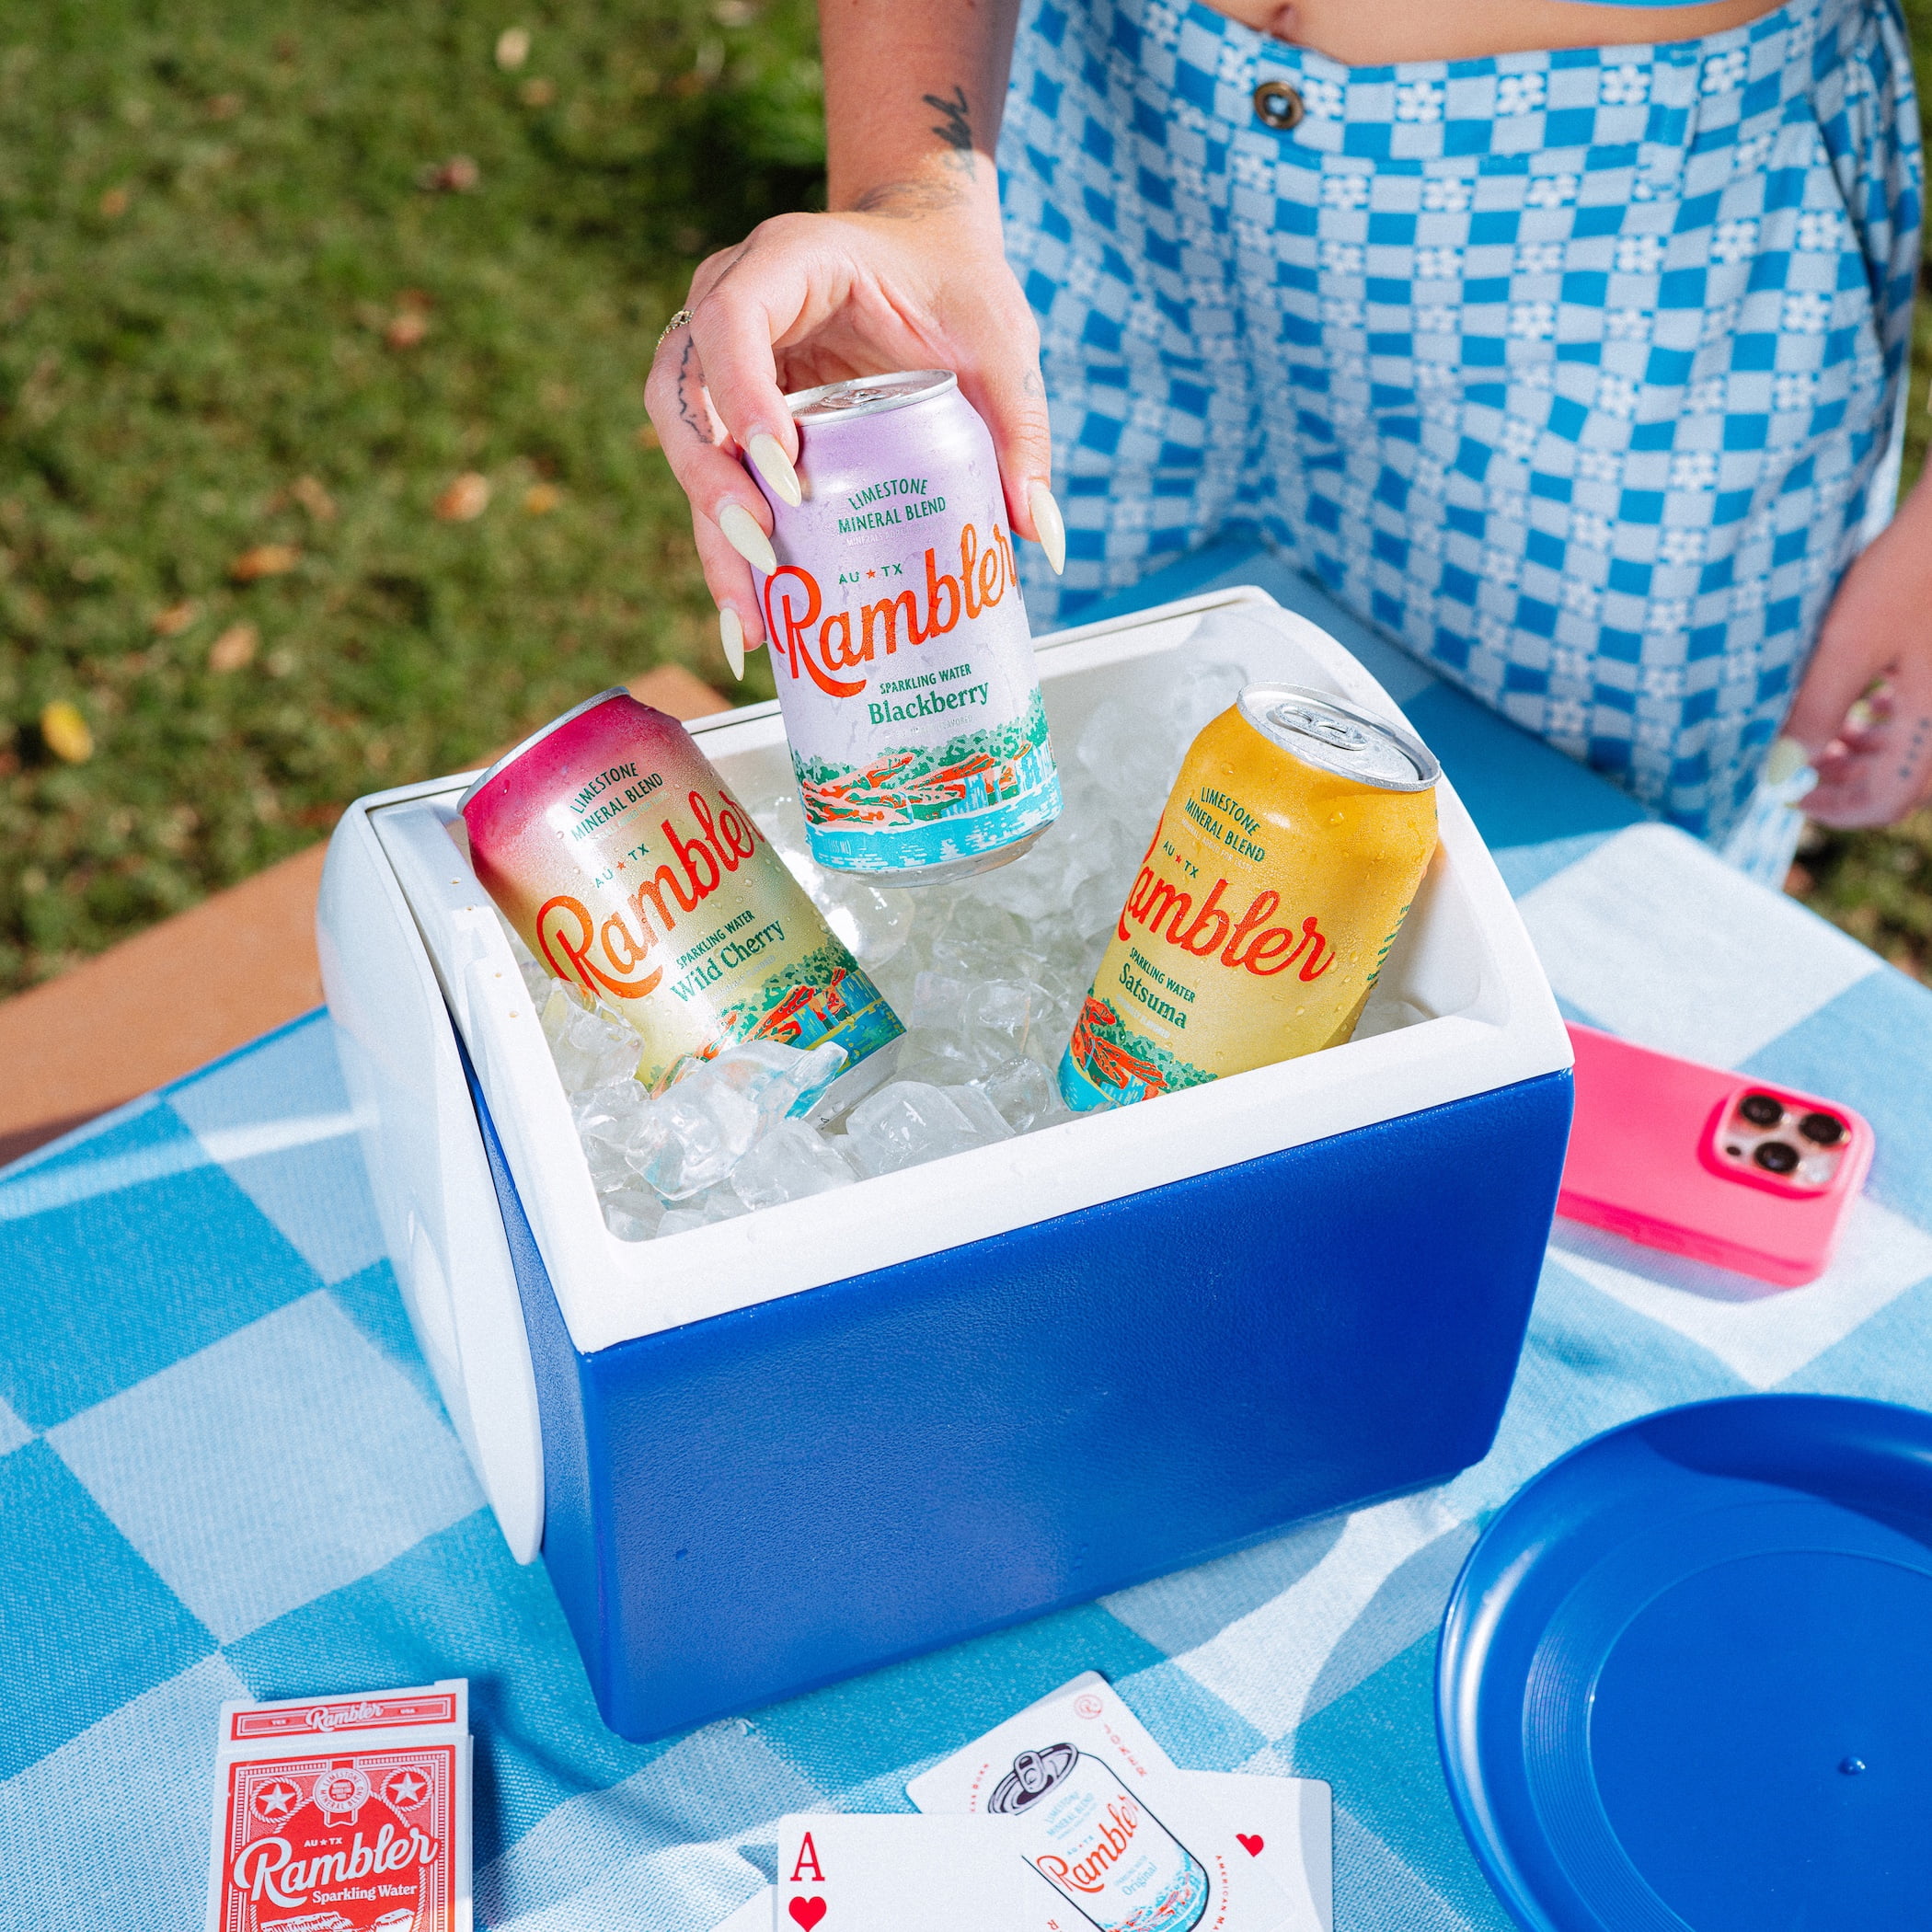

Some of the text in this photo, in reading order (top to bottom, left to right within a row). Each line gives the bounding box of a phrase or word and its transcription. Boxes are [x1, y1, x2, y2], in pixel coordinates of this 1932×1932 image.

[838, 508, 902, 534] MINERAL
[904, 497, 946, 521] BLEND
[848, 478, 928, 511] LIMESTONE
[839, 563, 903, 585] AU TX
[765, 523, 1016, 698] Rambler
[868, 682, 989, 725] Blackberry
[880, 663, 972, 695] SPARKLING WATER
[569, 763, 638, 814] LIMESTONE
[570, 797, 627, 842] MINERAL
[625, 773, 663, 803] BLEND
[1201, 787, 1260, 836] LIMESTONE
[1184, 798, 1221, 840] MINERAL
[1225, 830, 1265, 863] BLEND
[595, 844, 650, 889] AU TX
[1163, 840, 1199, 879] AU TX
[536, 790, 765, 999] Rambler
[670, 958, 723, 1002] Wild
[721, 920, 785, 969] Cherry
[676, 910, 755, 970] SPARKLING WATER
[1119, 962, 1187, 1029] Satsuma
[1129, 947, 1196, 1004] SPARKLING WATER
[305, 1701, 384, 1732] Rambler
[1104, 1723, 1147, 1777] JOKER
[233, 1823, 438, 1908] Rambler
[305, 1836, 343, 1848] AU TX
[789, 1831, 826, 1881] A
[1037, 1794, 1139, 1893] Rambler
[312, 1883, 418, 1905] Sparkling Water
[1121, 1861, 1157, 1896] Original
[1215, 1854, 1230, 1912] AMERICAN
